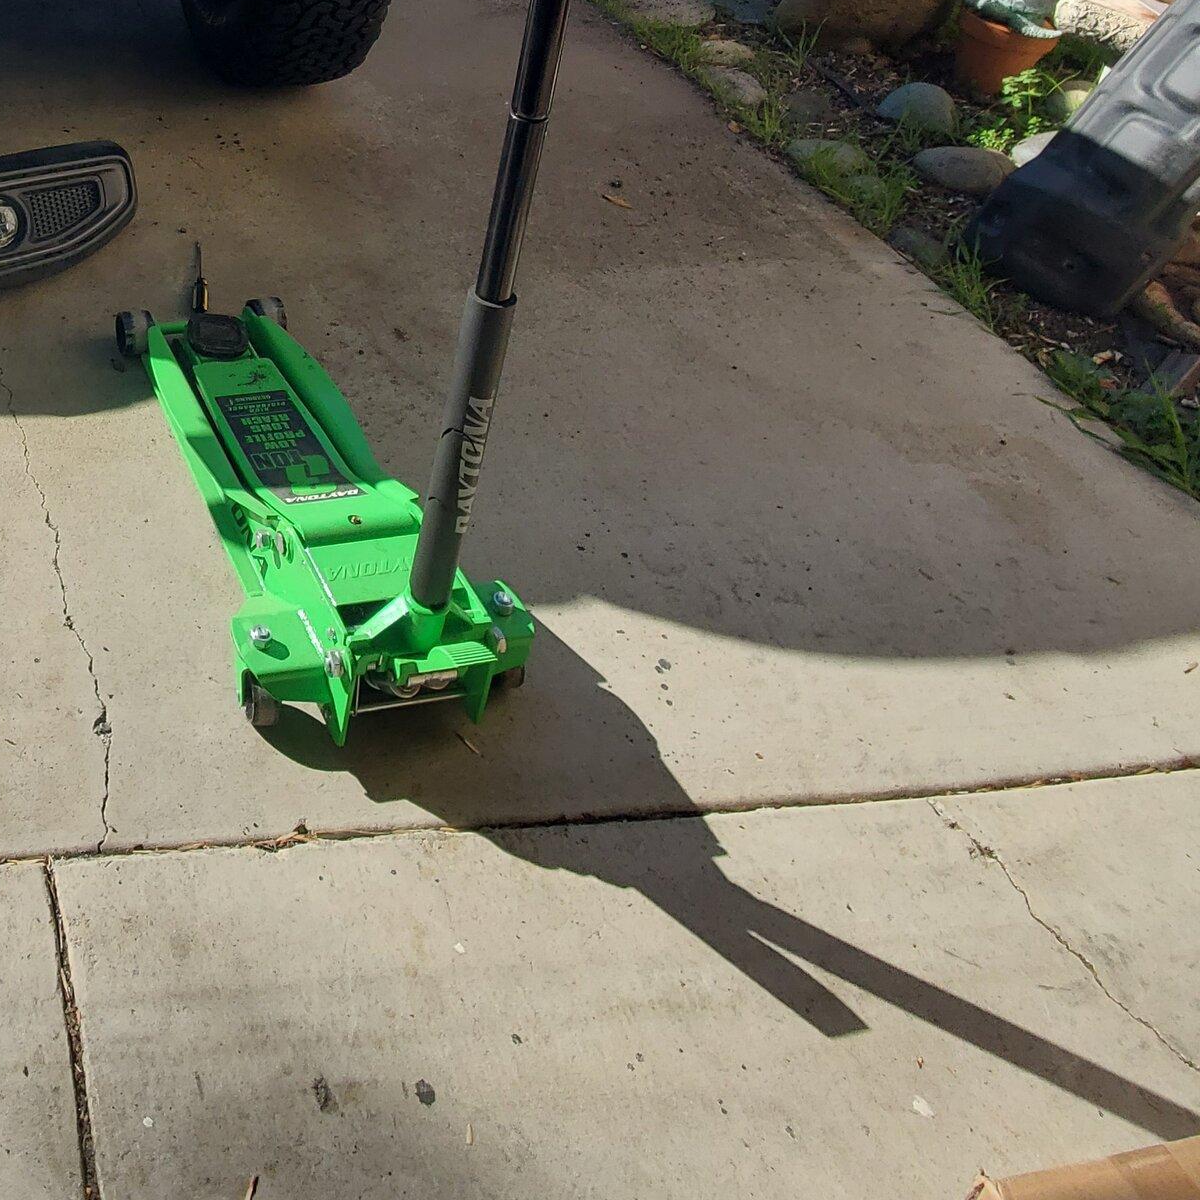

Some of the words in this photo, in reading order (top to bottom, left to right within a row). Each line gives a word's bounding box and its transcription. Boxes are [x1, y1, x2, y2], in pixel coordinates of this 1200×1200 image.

[240, 413, 290, 425] REACH
[250, 422, 290, 432] LONG
[244, 429, 306, 443] PROFILE
[263, 439, 297, 450] LOW
[250, 449, 303, 471] TON
[455, 396, 494, 534] DAYTONA
[285, 488, 359, 503] DAYTONA
[328, 557, 409, 582] YTONA
